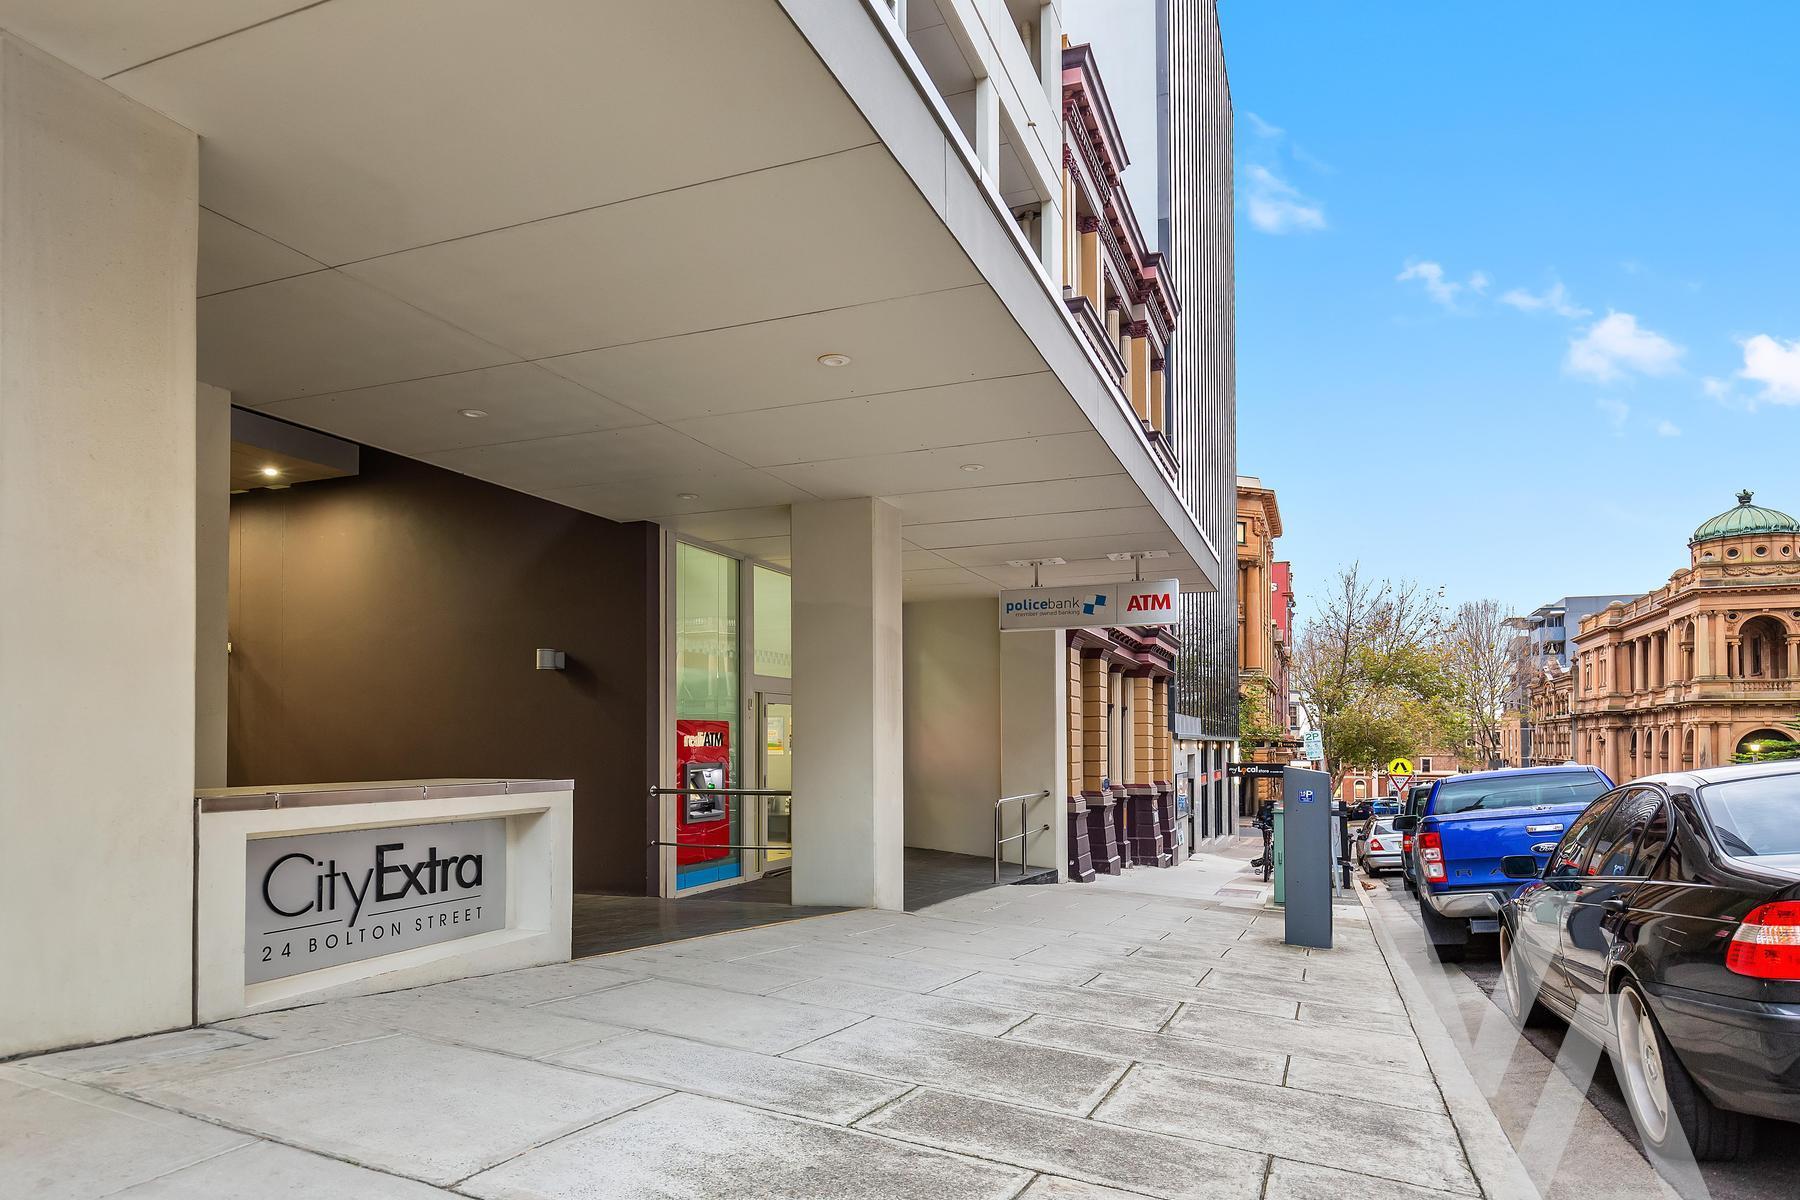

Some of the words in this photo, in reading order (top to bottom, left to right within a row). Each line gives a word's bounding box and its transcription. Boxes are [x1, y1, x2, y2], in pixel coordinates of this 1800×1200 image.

[1006, 597, 1080, 614] policebank
[1127, 593, 1171, 612] ATM
[1305, 732, 1319, 741] 2P
[262, 942, 292, 962] 24
[308, 921, 401, 953] BOLTON
[415, 906, 483, 932] STREET
